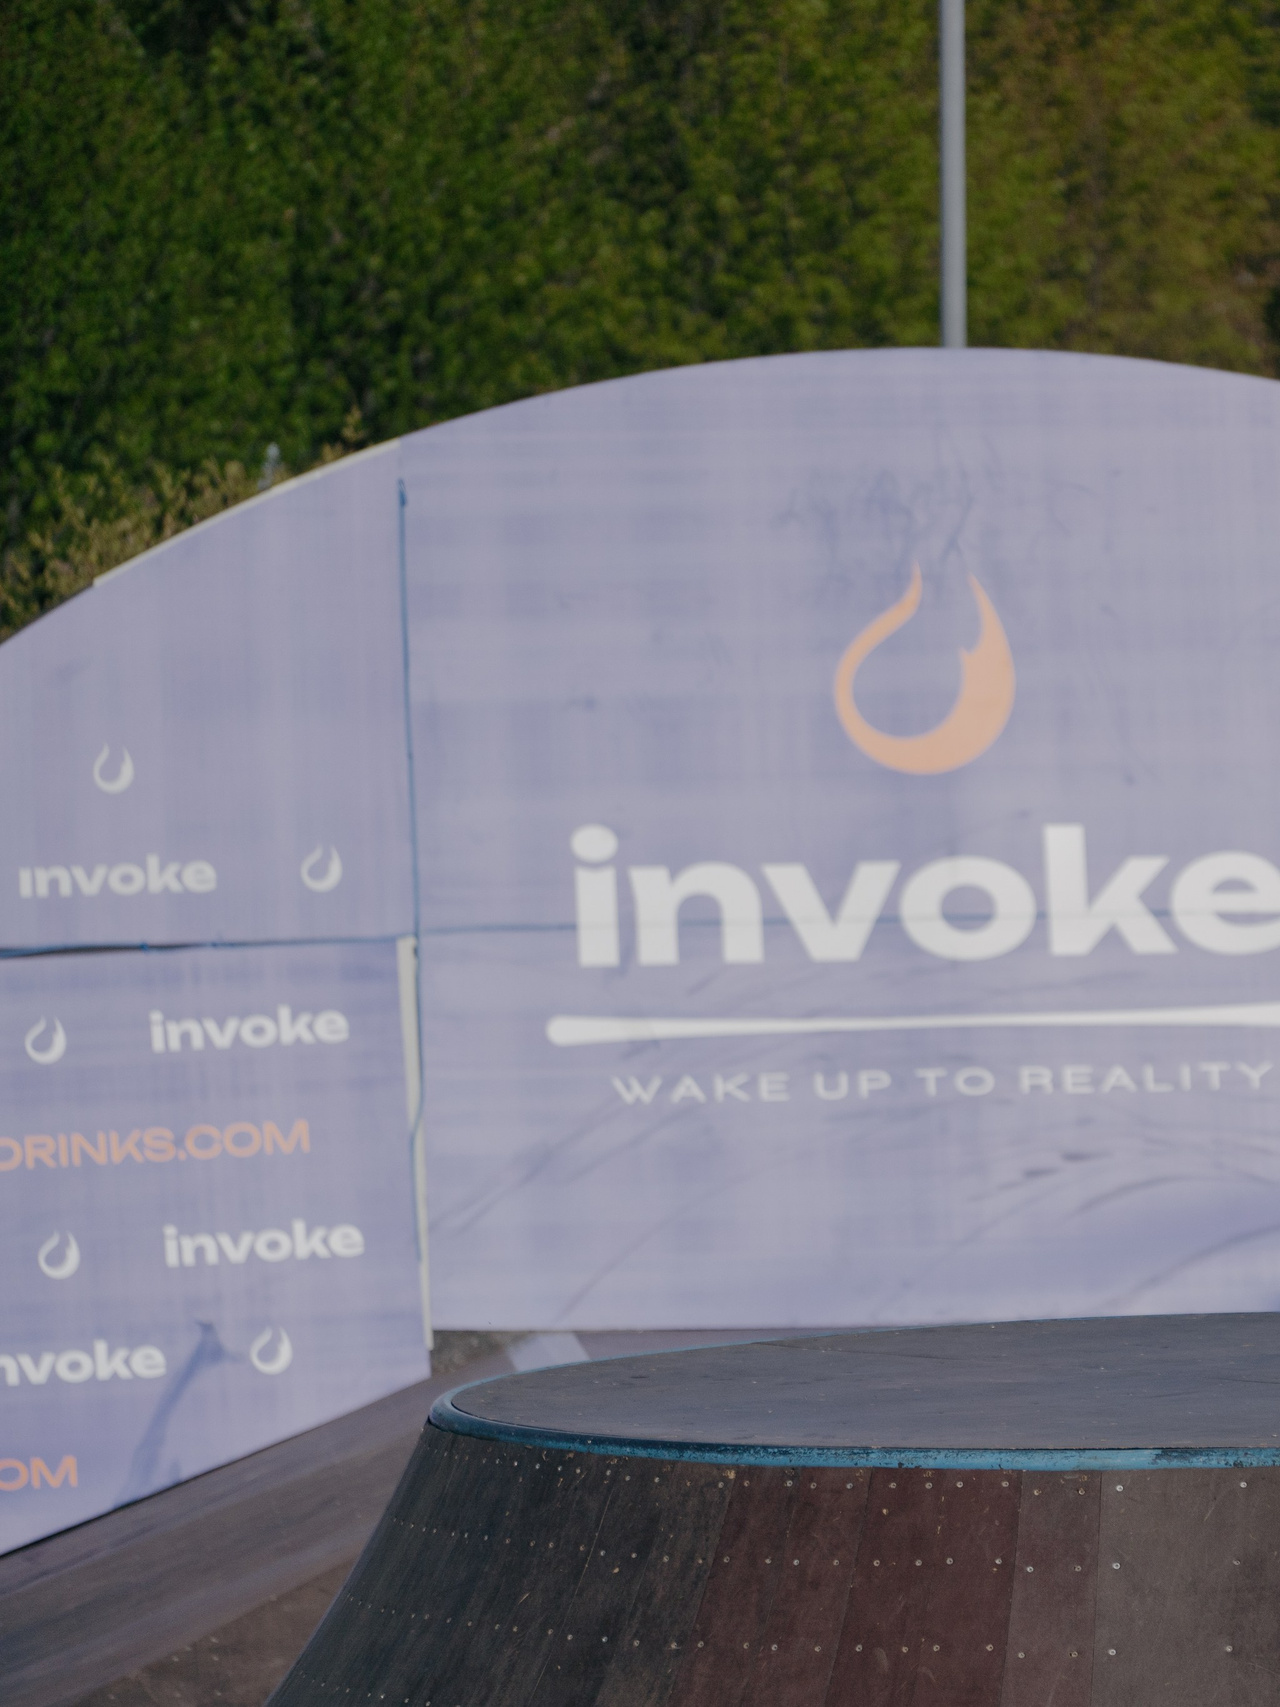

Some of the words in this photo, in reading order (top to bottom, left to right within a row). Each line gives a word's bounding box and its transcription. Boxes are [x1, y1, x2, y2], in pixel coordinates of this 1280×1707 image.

[19, 853, 217, 898] invoke
[149, 1003, 350, 1053] invoke
[611, 1071, 790, 1105] WAKE
[813, 1068, 892, 1101] UP
[915, 1066, 996, 1098] TO
[1020, 1061, 1276, 1095] REALITY
[163, 1218, 365, 1268] invoke
